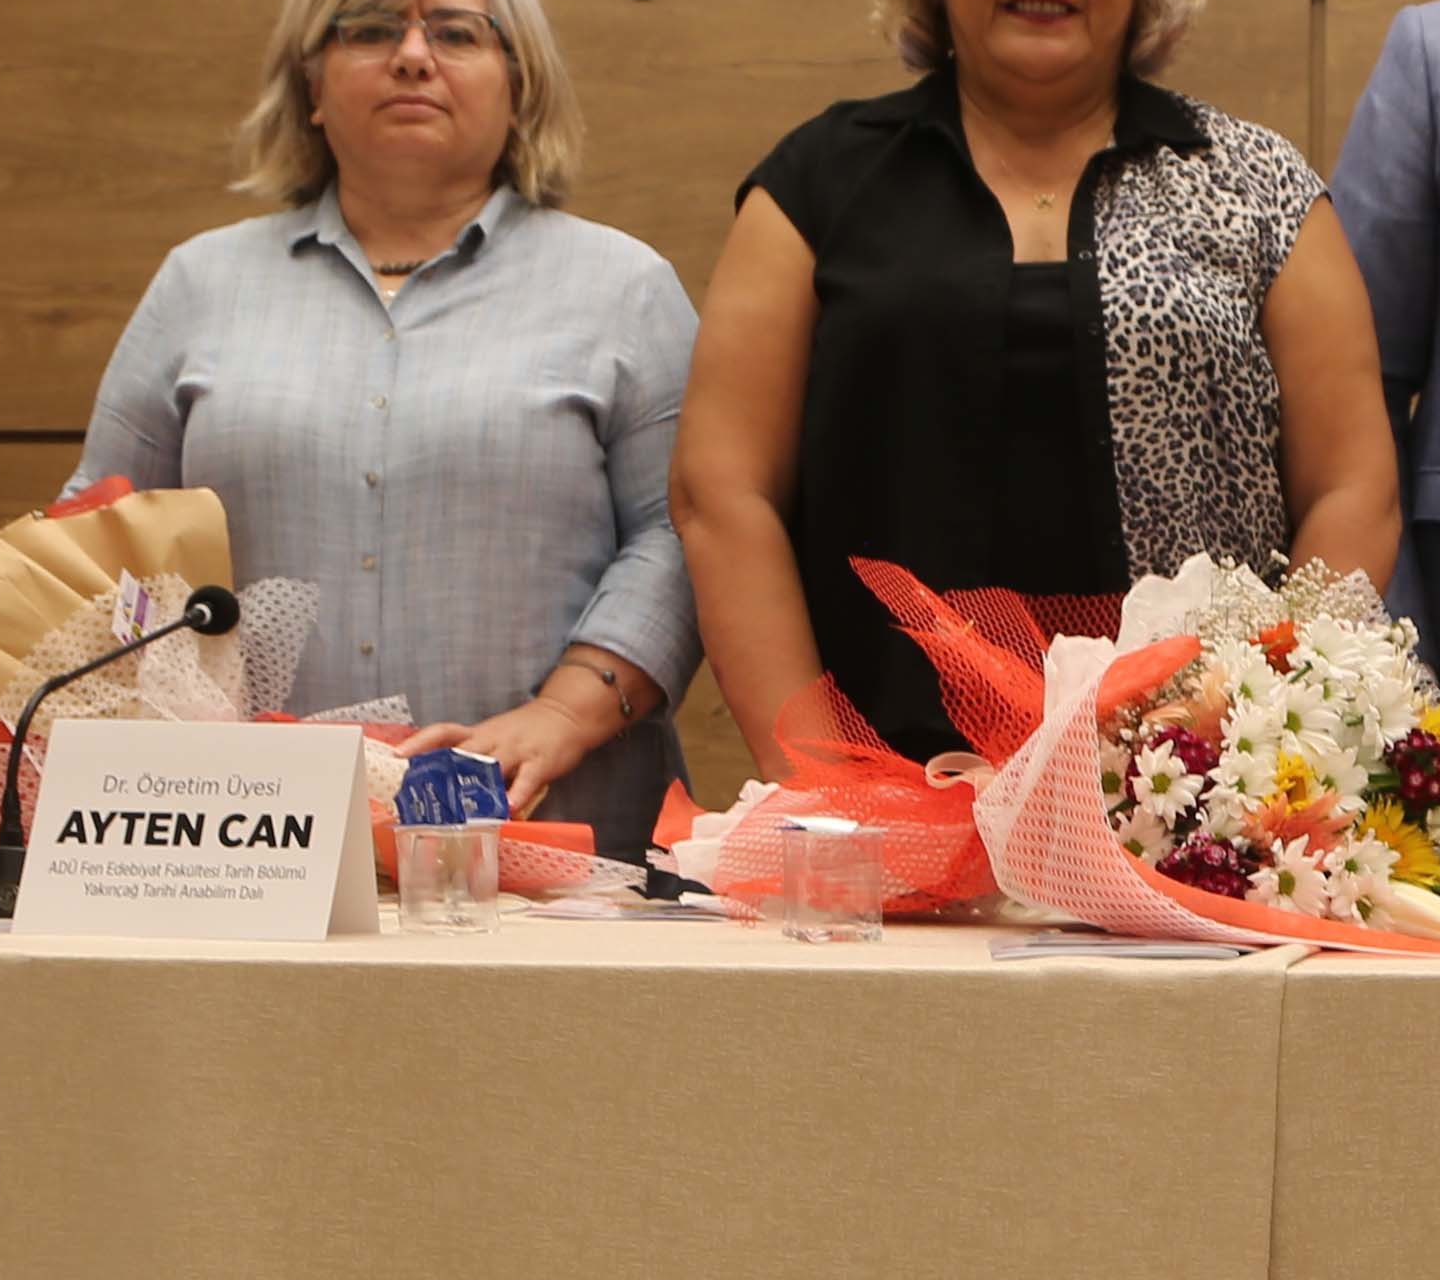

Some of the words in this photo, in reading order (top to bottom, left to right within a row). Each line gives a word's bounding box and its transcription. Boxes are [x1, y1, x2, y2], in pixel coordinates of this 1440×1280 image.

[101, 773, 130, 795] Dr.
[135, 773, 221, 798] Öğretim
[225, 773, 283, 801] Üyesi
[55, 808, 207, 848] AYTEN
[217, 812, 315, 850] CAN
[80, 859, 105, 876] Fen
[106, 860, 162, 880] Edebiyat
[163, 861, 222, 879] Fakültesi
[178, 883, 238, 900] Anabilim
